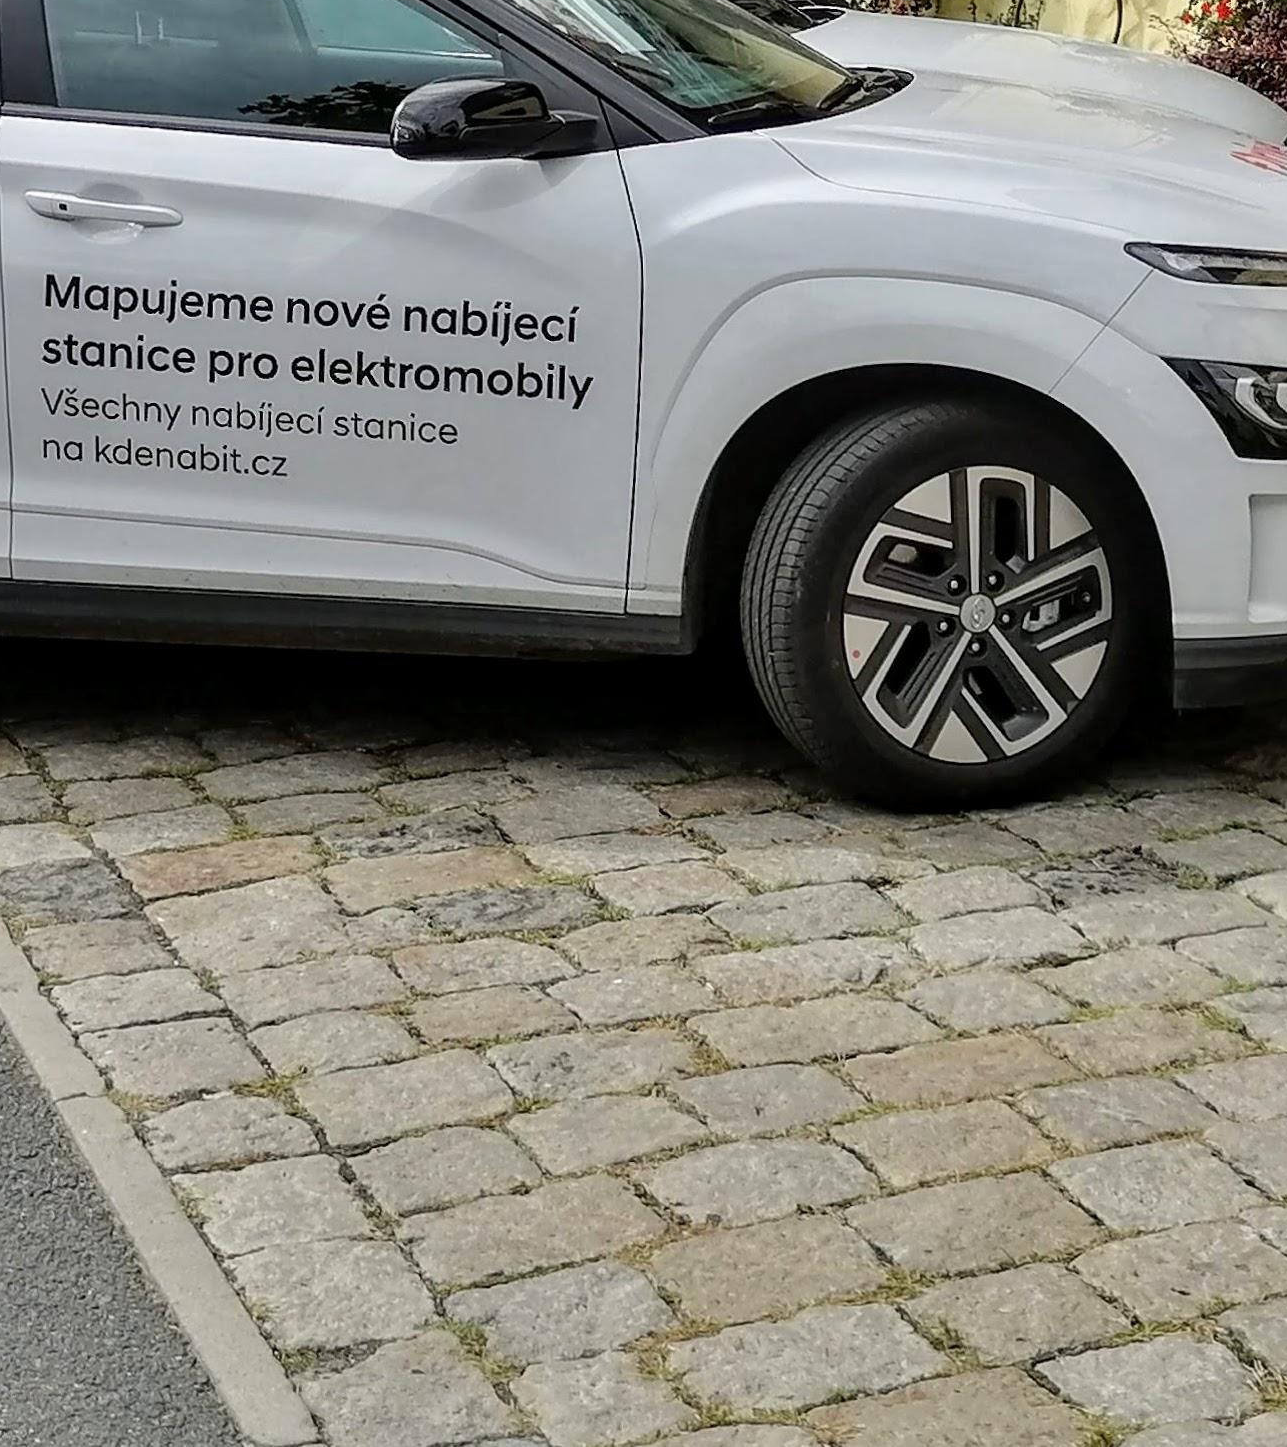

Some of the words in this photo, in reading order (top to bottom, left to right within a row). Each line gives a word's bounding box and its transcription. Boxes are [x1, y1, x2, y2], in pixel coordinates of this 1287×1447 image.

[43, 273, 275, 325] Mapujeme
[286, 293, 392, 332] nové
[403, 299, 581, 348] nabíjecí
[41, 333, 197, 375] stanice
[208, 349, 280, 385] pro
[290, 348, 595, 411] elektromobily
[40, 386, 182, 432] Všechny
[191, 400, 326, 439] nabíjecí
[332, 411, 460, 446] stanice
[42, 439, 83, 462] na
[94, 435, 288, 478] kdenabit.cz
